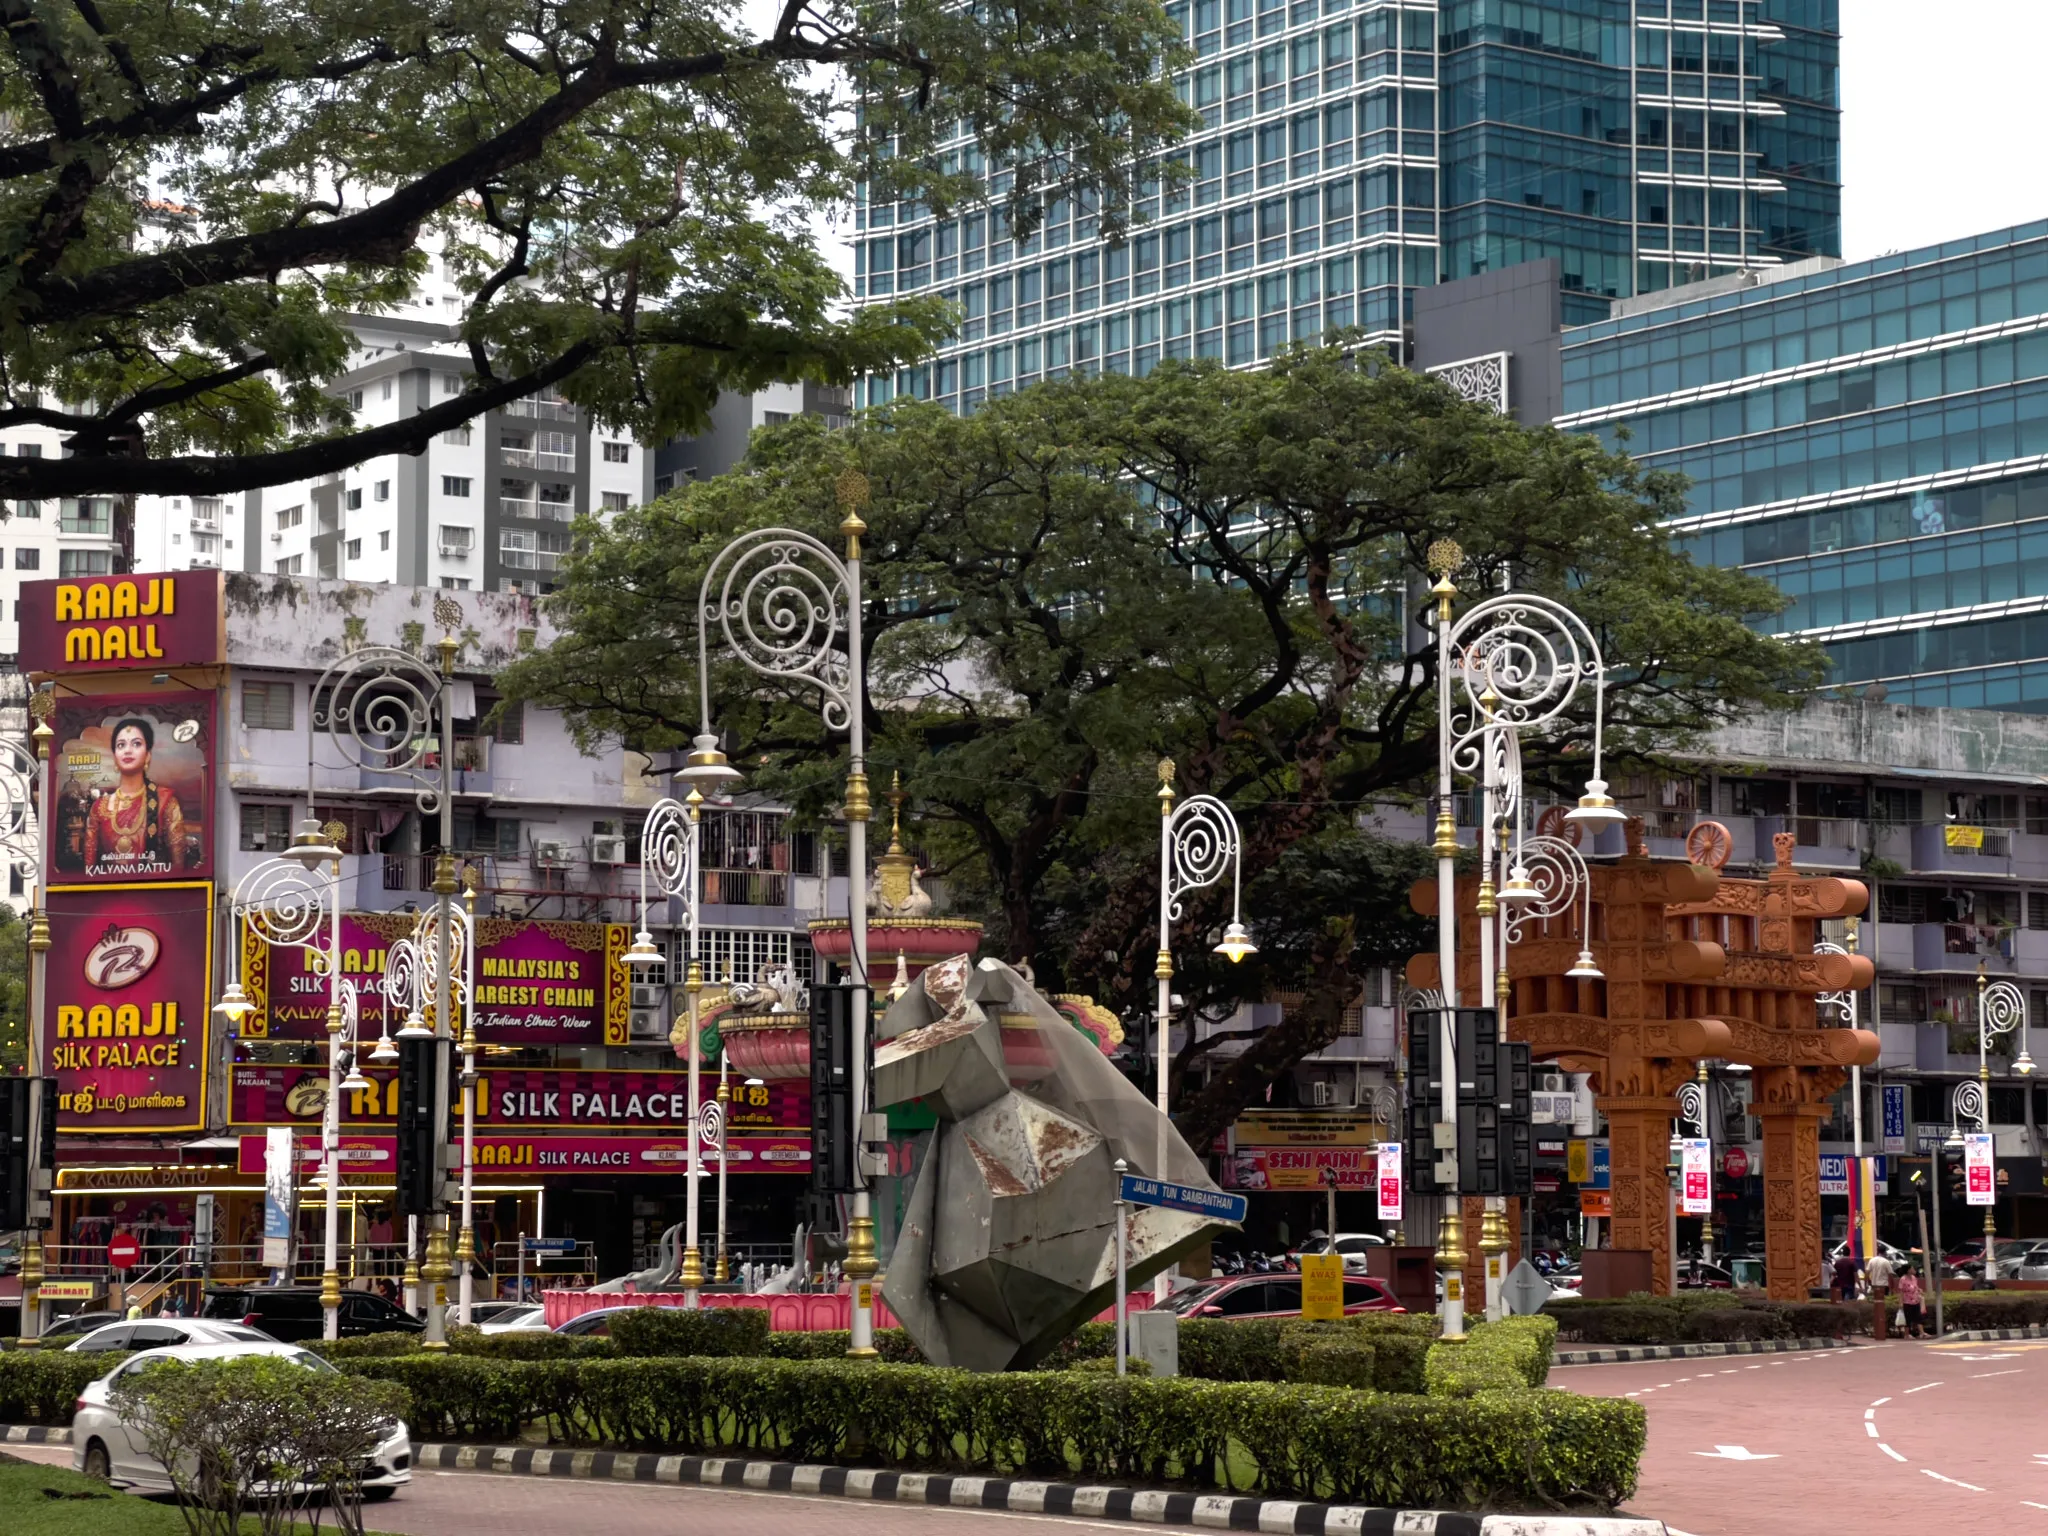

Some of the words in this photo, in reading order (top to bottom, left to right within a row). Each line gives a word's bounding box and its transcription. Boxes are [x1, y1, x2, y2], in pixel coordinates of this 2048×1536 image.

[55, 578, 175, 622] RAAJI
[65, 624, 164, 662] MALL
[68, 753, 100, 765] RAAJI
[85, 864, 136, 877] KALYANA
[138, 862, 172, 874] PATTU
[483, 957, 580, 980] MALAYSIA'S
[289, 976, 324, 993] SILK
[475, 985, 539, 1005] ARGEST
[543, 987, 594, 1007] CHAIN
[57, 1002, 177, 1039] RAAJI
[484, 1013, 522, 1027] Indian
[524, 1013, 558, 1029] Ethnic
[559, 1014, 591, 1029] Wear
[52, 1045, 91, 1068] SILK
[98, 1044, 178, 1067] PALACE
[501, 1092, 560, 1117] SILK
[571, 1093, 684, 1118] PALACE
[1885, 1088, 1893, 1135] KLINIK
[539, 1152, 568, 1165] SILK
[573, 1152, 630, 1165] PALACE
[1268, 1152, 1312, 1169] SENI
[1315, 1152, 1360, 1169] MINI
[84, 1172, 155, 1188] KALYANA
[162, 1171, 208, 1185] PATTU
[1133, 1180, 1157, 1196] JALAN
[1162, 1185, 1177, 1199] TUN
[1181, 1189, 1233, 1210] SAMBANTHAN
[1311, 1271, 1336, 1279] AWAS
